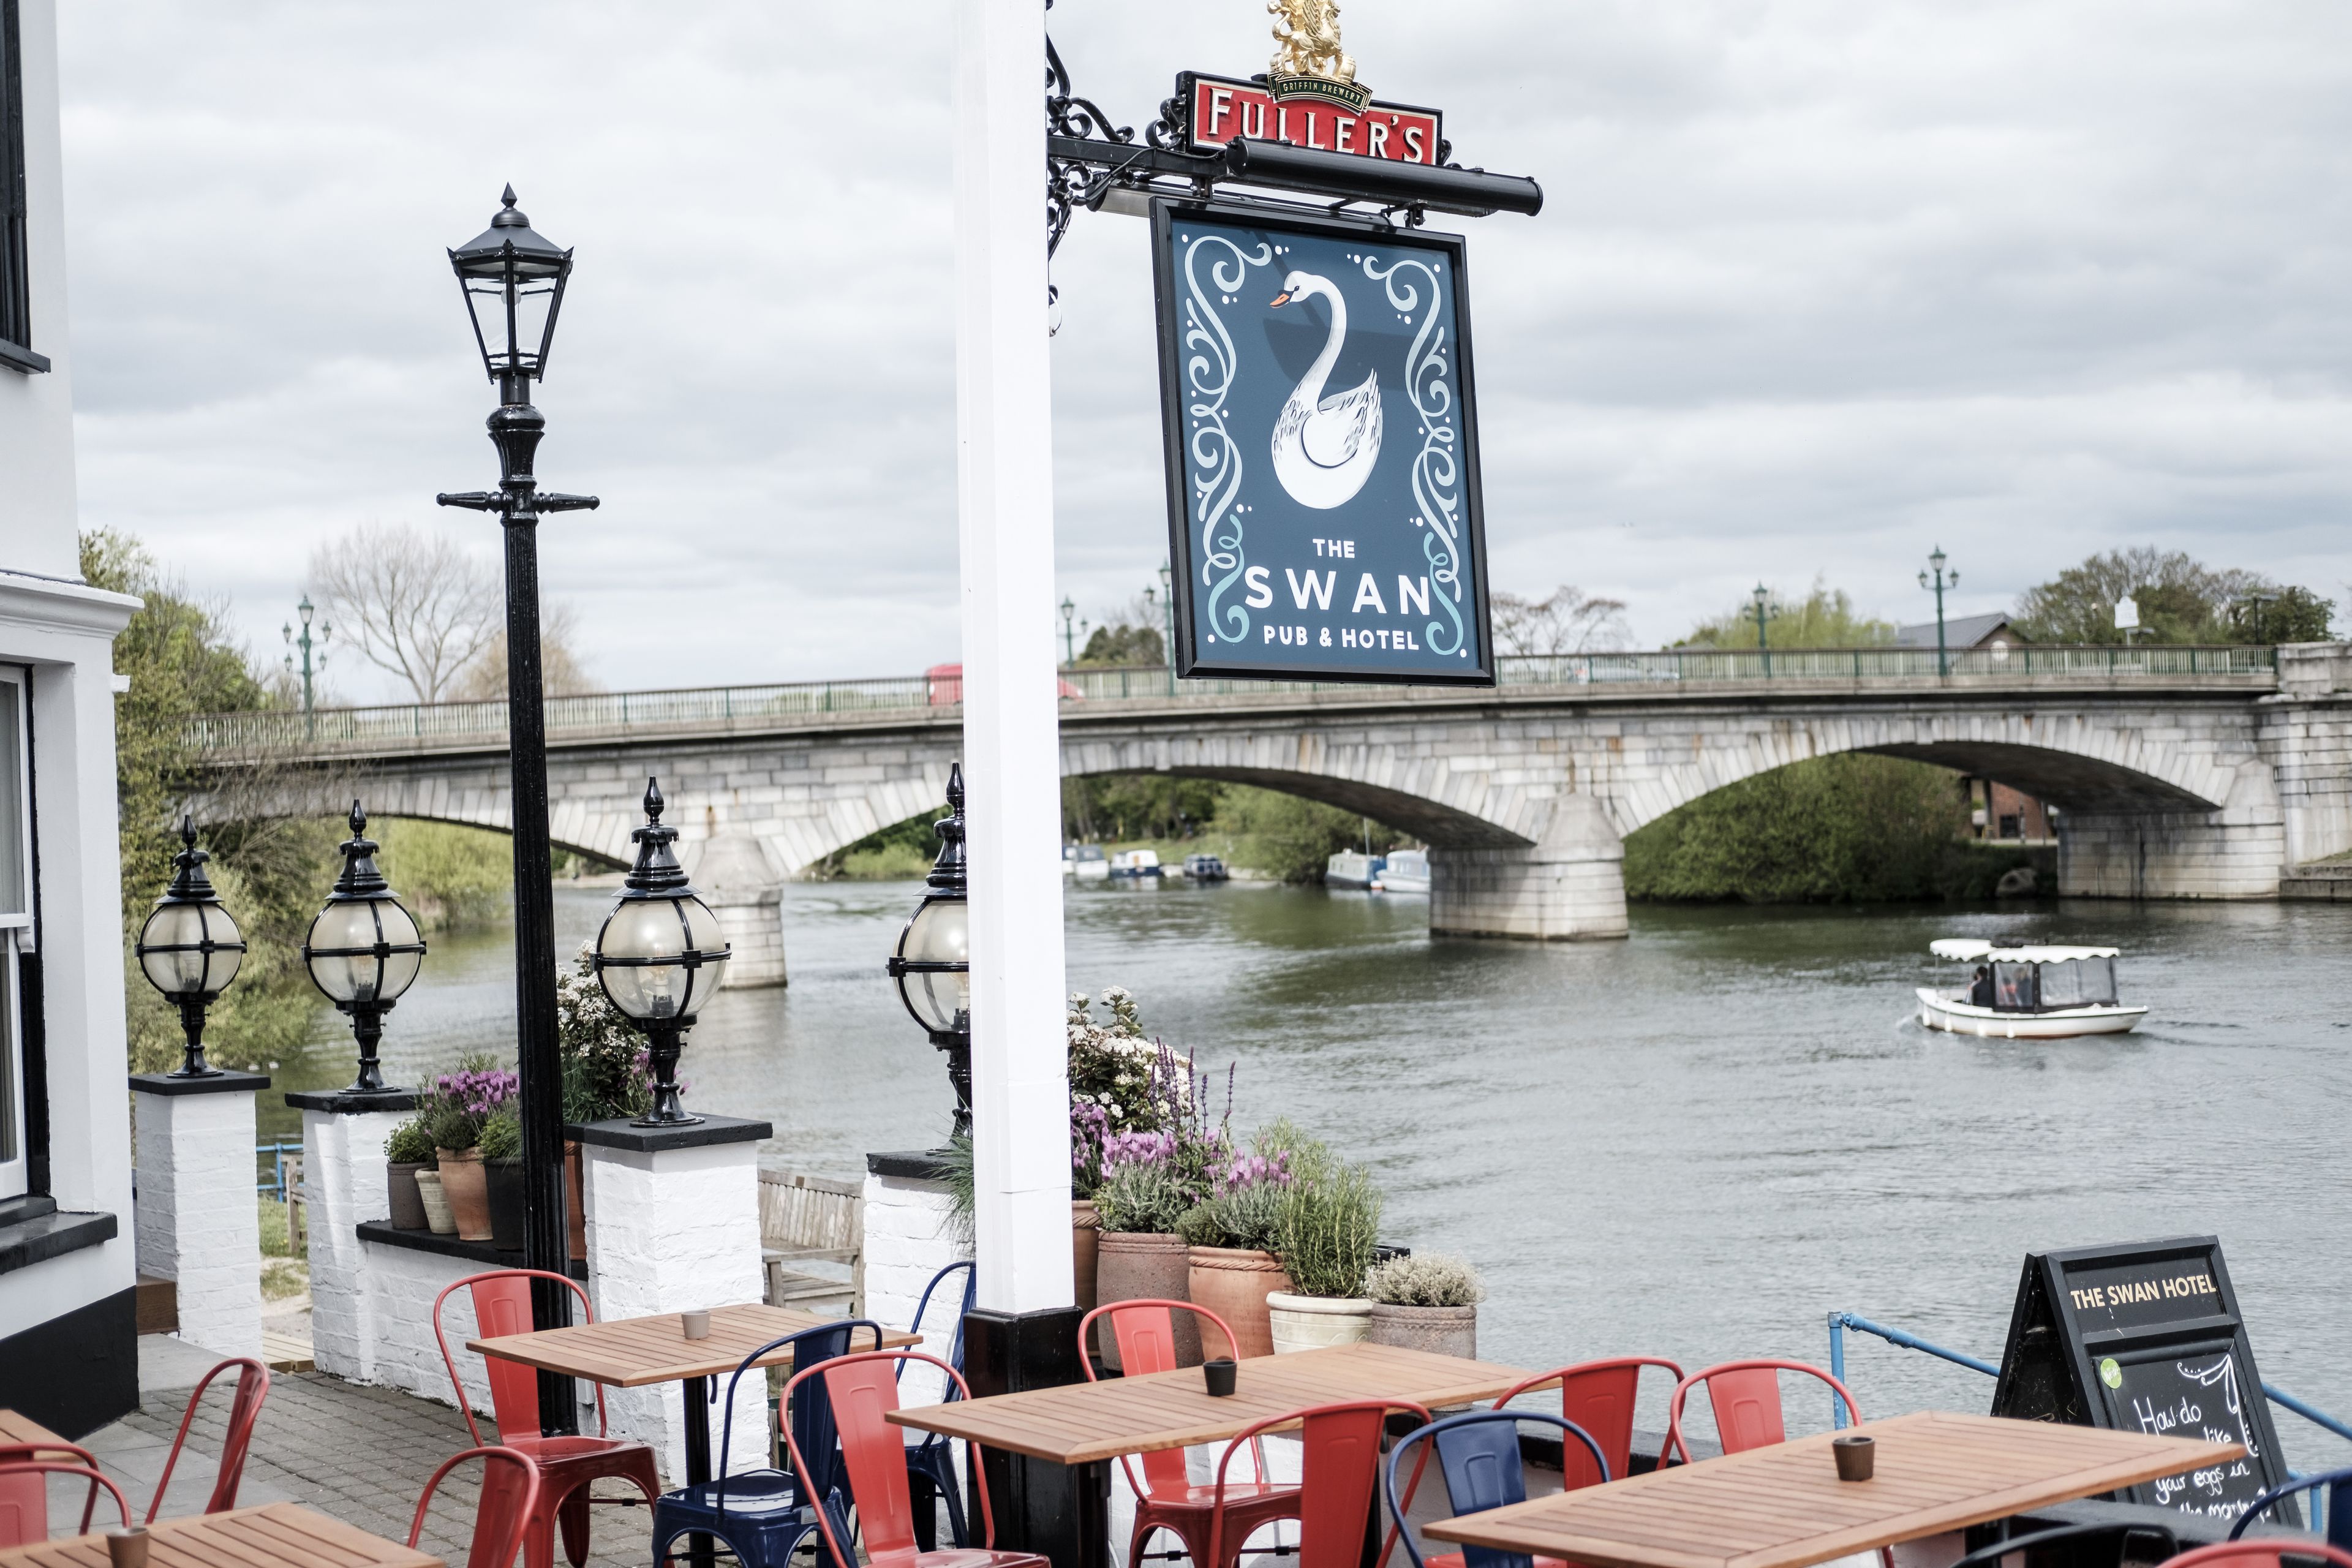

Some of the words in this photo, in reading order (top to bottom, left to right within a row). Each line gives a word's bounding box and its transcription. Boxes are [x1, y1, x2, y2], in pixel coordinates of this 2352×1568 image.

[1283, 82, 1317, 91] GRIFFIN
[1322, 84, 1360, 103] BREWERY
[1206, 88, 1424, 163] FULLER'S
[1312, 538, 1355, 559] THE
[1244, 565, 1431, 616] SWAN
[1263, 625, 1308, 646] PUB
[1319, 627, 1333, 647] &
[1341, 628, 1420, 650] HOTEL
[2070, 1287, 2106, 1310] THE
[2107, 1280, 2160, 1305] SWAN
[2162, 1274, 2217, 1298] HOTEL
[2133, 1396, 2176, 1437] How
[2180, 1396, 2201, 1424] do
[2203, 1425, 2232, 1444] like
[2155, 1475, 2186, 1505] your
[2193, 1465, 2225, 1496] eggs
[2229, 1457, 2250, 1478] in
